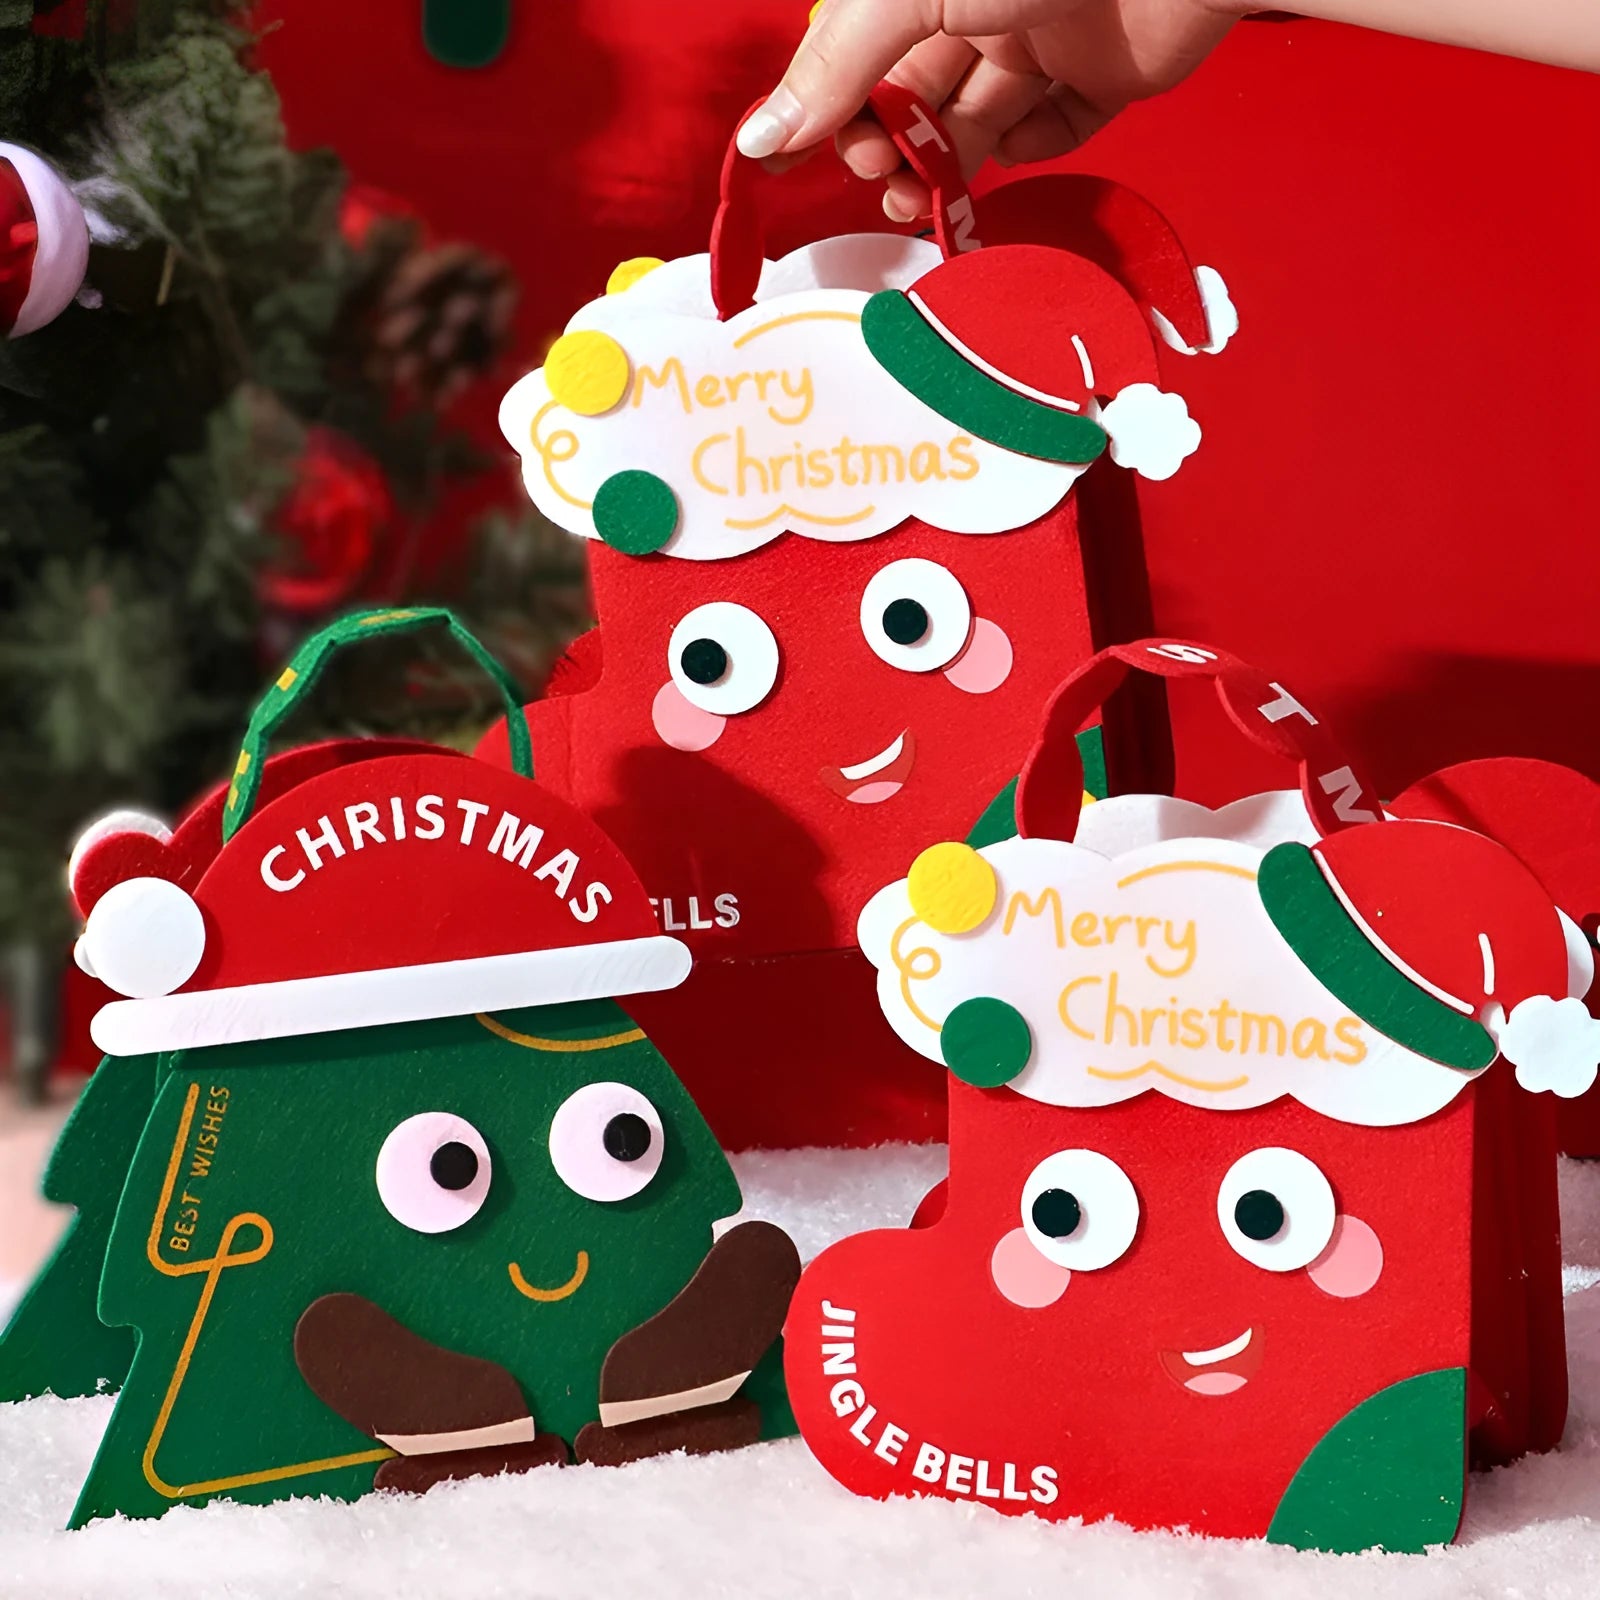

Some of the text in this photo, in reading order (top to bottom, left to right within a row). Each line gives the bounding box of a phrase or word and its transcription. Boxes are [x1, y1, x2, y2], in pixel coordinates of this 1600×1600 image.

[632, 357, 815, 426] Merry
[691, 425, 981, 497] Christmas
[260, 794, 613, 923] CHRISTMAS
[1003, 887, 1197, 978] Merry
[1057, 970, 1368, 1066] Christmas
[169, 1085, 231, 1252] BEST WISHES
[820, 1300, 1059, 1505] JINGLE BELLS
